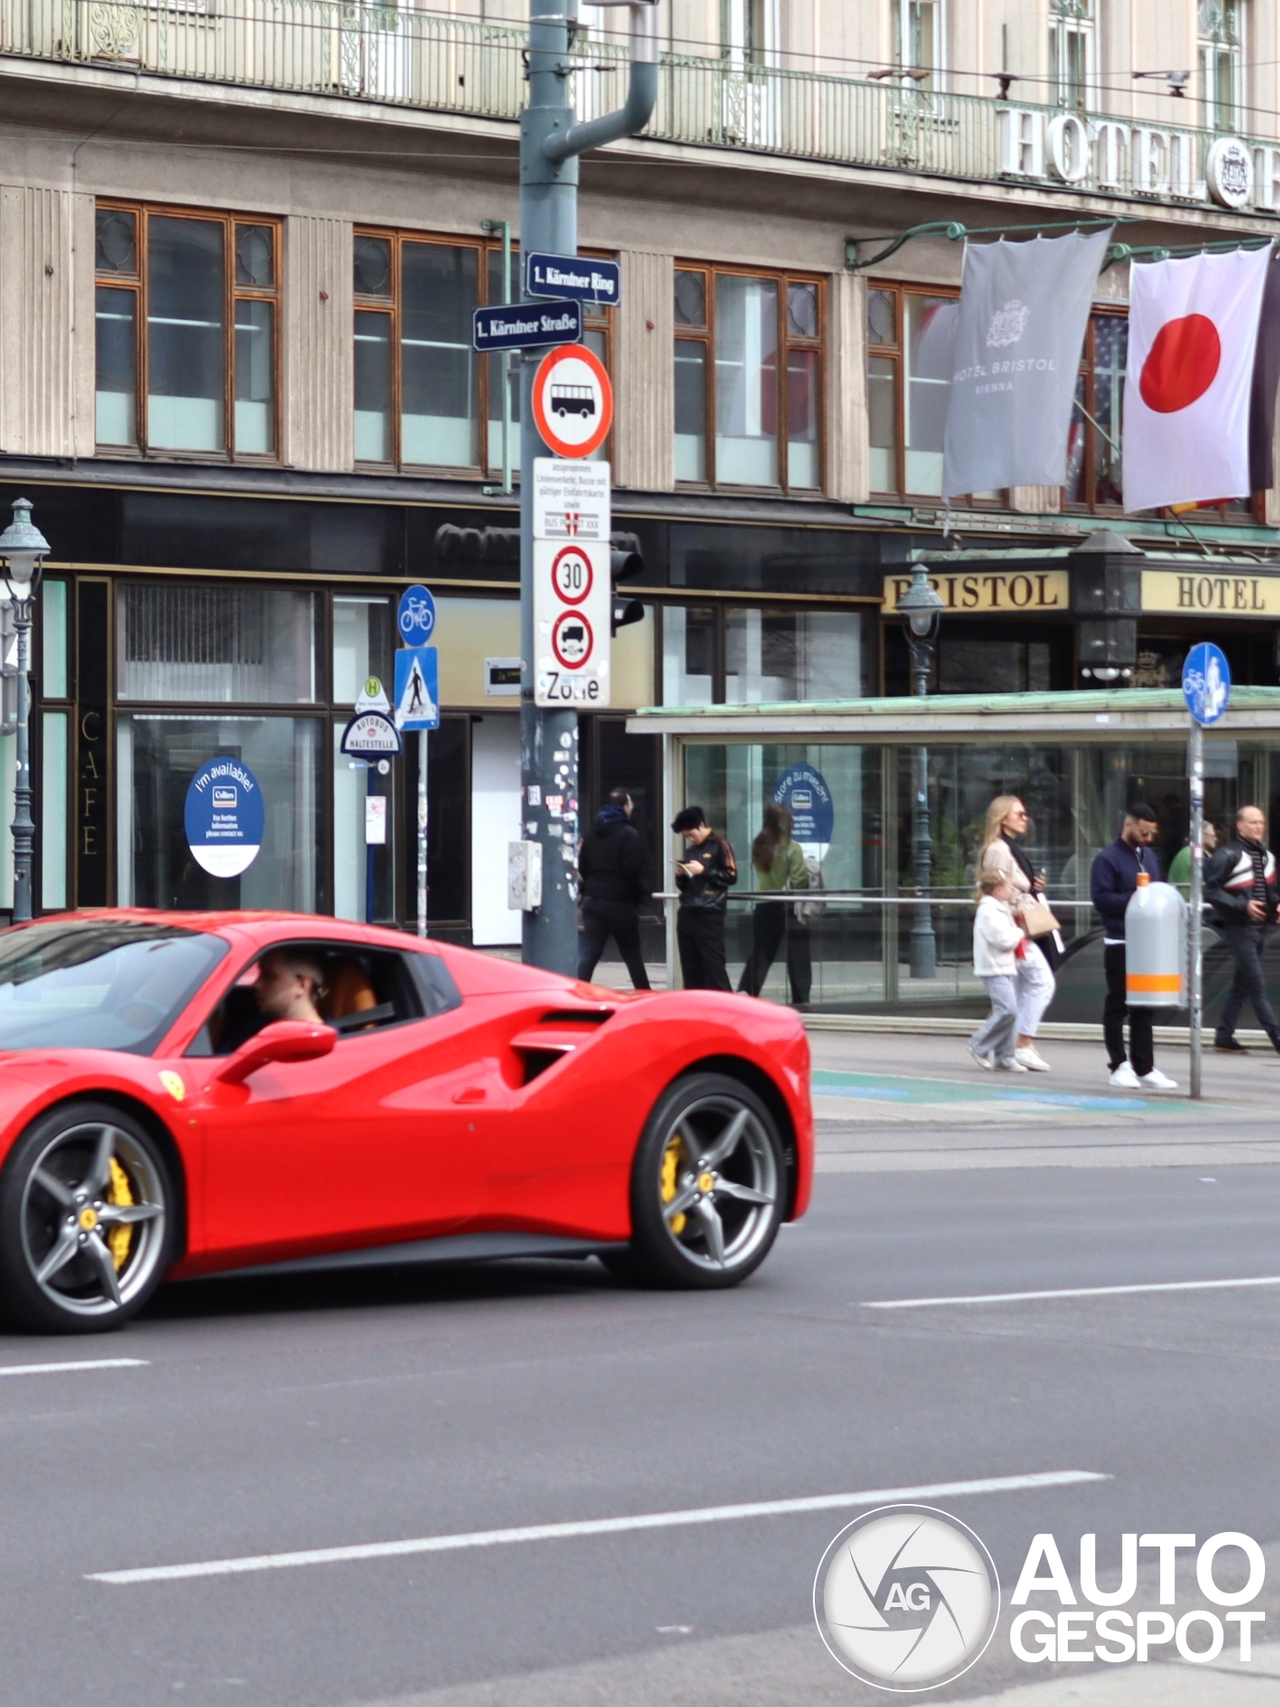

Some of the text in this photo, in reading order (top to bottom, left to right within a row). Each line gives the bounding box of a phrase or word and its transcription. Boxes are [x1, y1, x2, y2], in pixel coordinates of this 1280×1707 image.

[996, 107, 1209, 201] HOTEL
[546, 267, 590, 288] Kärntner
[591, 272, 615, 295] Ring
[490, 319, 540, 337] Kärntner
[540, 313, 577, 332] Straße
[991, 358, 1056, 374] BRISTOL
[975, 381, 1013, 395] VIENNA
[563, 563, 582, 589] 30
[891, 575, 1058, 609] BISTOL
[1176, 576, 1265, 611] HOTEL
[546, 672, 599, 700] Zoe
[356, 717, 389, 733] AUTOBUS
[349, 739, 394, 749] HALTESTELLE
[81, 711, 100, 855] CAFE
[195, 763, 254, 793] I'm available!
[773, 776, 793, 804] Store
[793, 771, 802, 782] zu
